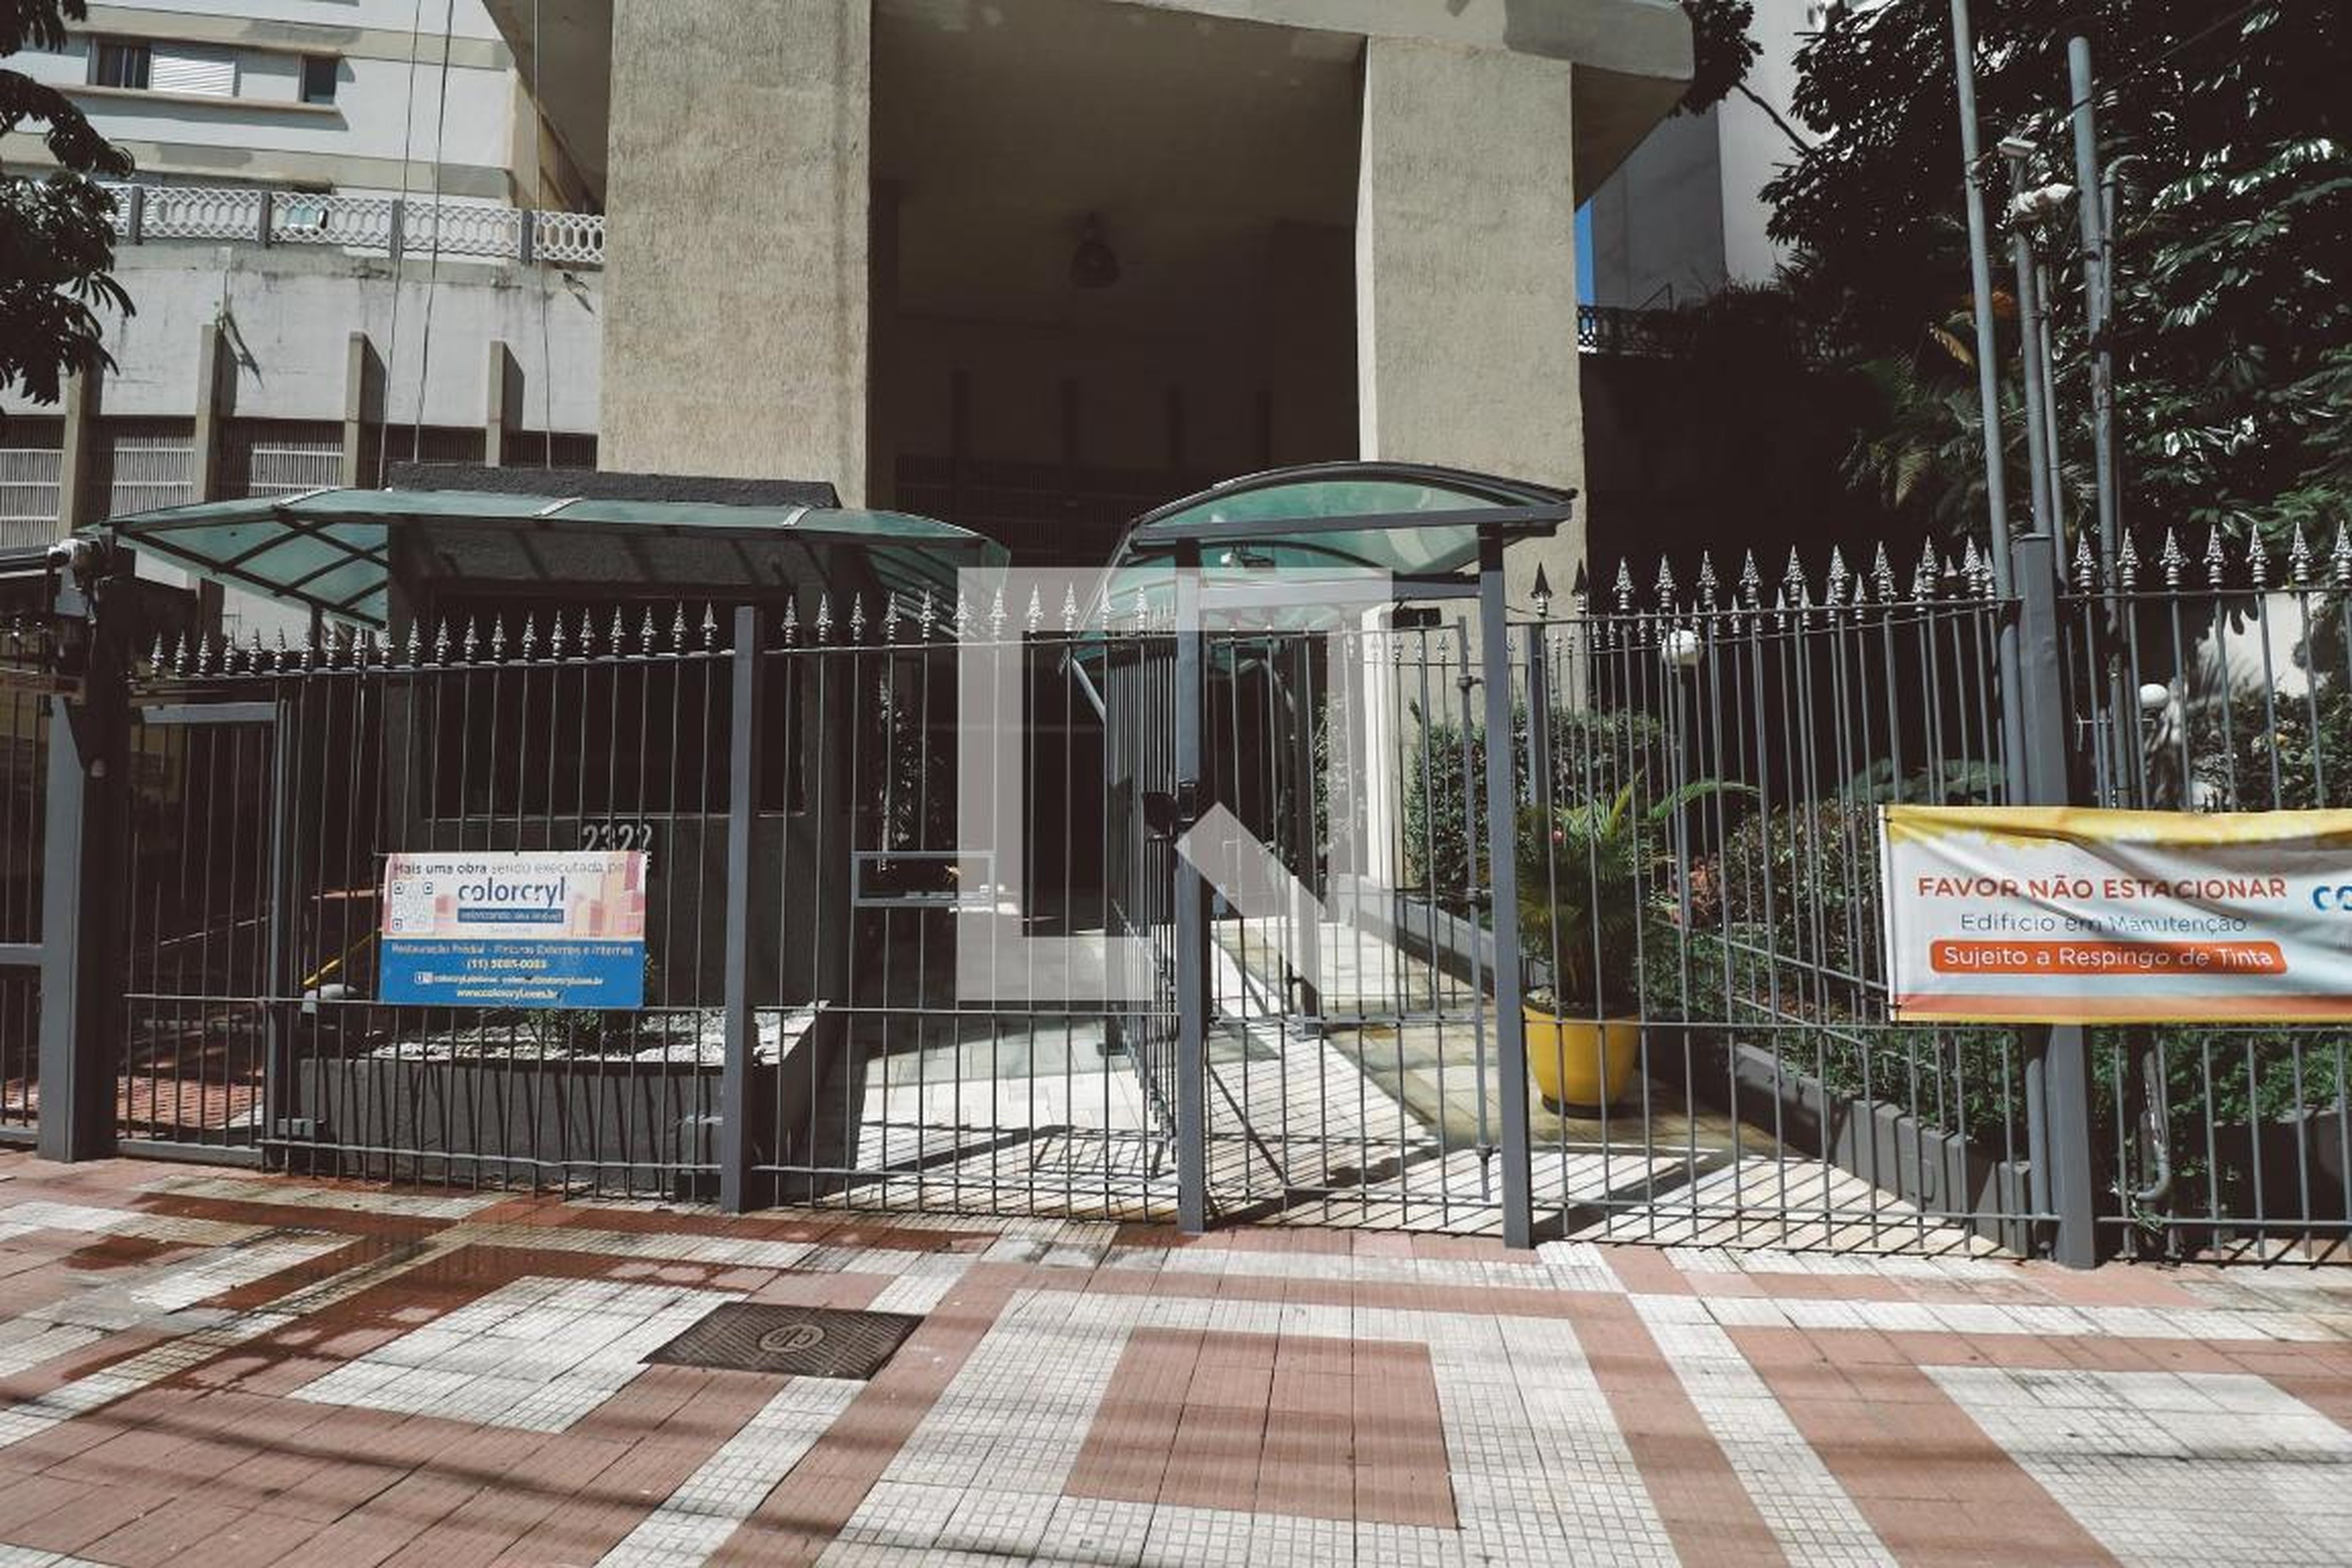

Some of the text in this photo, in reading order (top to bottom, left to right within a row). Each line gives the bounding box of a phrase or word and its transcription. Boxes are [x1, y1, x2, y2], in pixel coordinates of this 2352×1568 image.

[426, 864, 454, 875] uma
[457, 863, 487, 875] obra
[534, 860, 603, 874] executada
[458, 876, 565, 907] colorcryl
[1918, 874, 2287, 899] FAVOR NÃO ESTACIONAR
[2064, 916, 2101, 933] em
[2108, 913, 2247, 934] Manutenção
[1943, 947, 2274, 968] Sujeito a Respingo de Tinta
